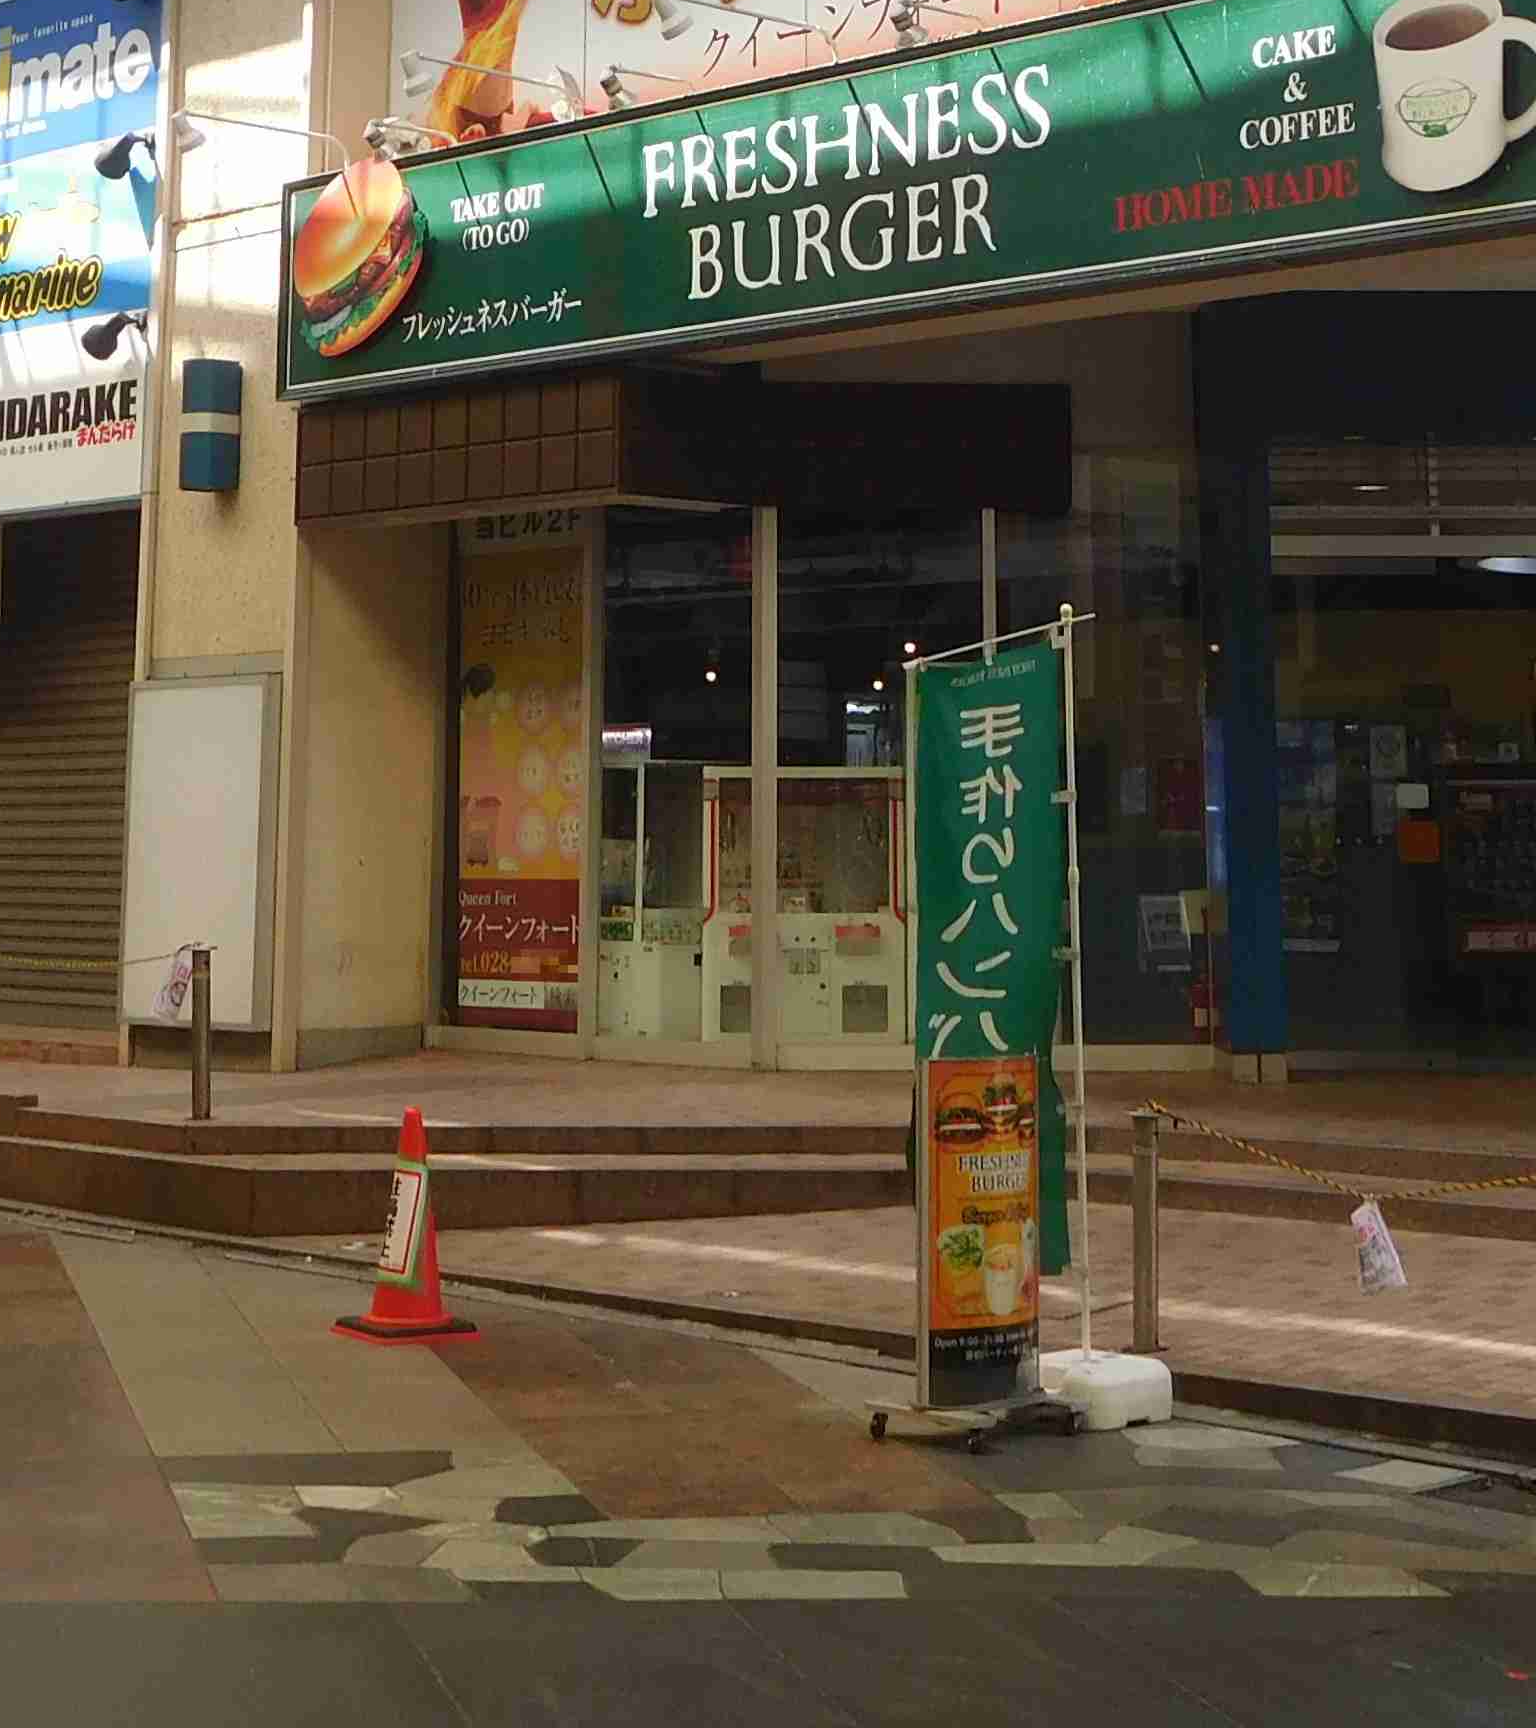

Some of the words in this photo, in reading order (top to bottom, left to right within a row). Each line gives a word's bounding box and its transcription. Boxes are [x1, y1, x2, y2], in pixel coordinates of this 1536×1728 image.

[1251, 24, 1336, 69] CAKE
[1282, 71, 1308, 103] &
[642, 62, 1053, 218] FRESHNESS
[1239, 102, 1357, 151] COFFEE
[450, 192, 500, 225] TAKE
[504, 182, 545, 214] OUT
[1114, 176, 1234, 234] HOME
[1240, 158, 1361, 217] MADE
[461, 222, 492, 252] (TO
[494, 217, 532, 249] GO)
[687, 172, 997, 302] BURGER
[401, 291, 583, 345] フレッシュネスバーガー
[75, 420, 137, 448] まんだらけ
[458, 911, 579, 945] クイーンフォート
